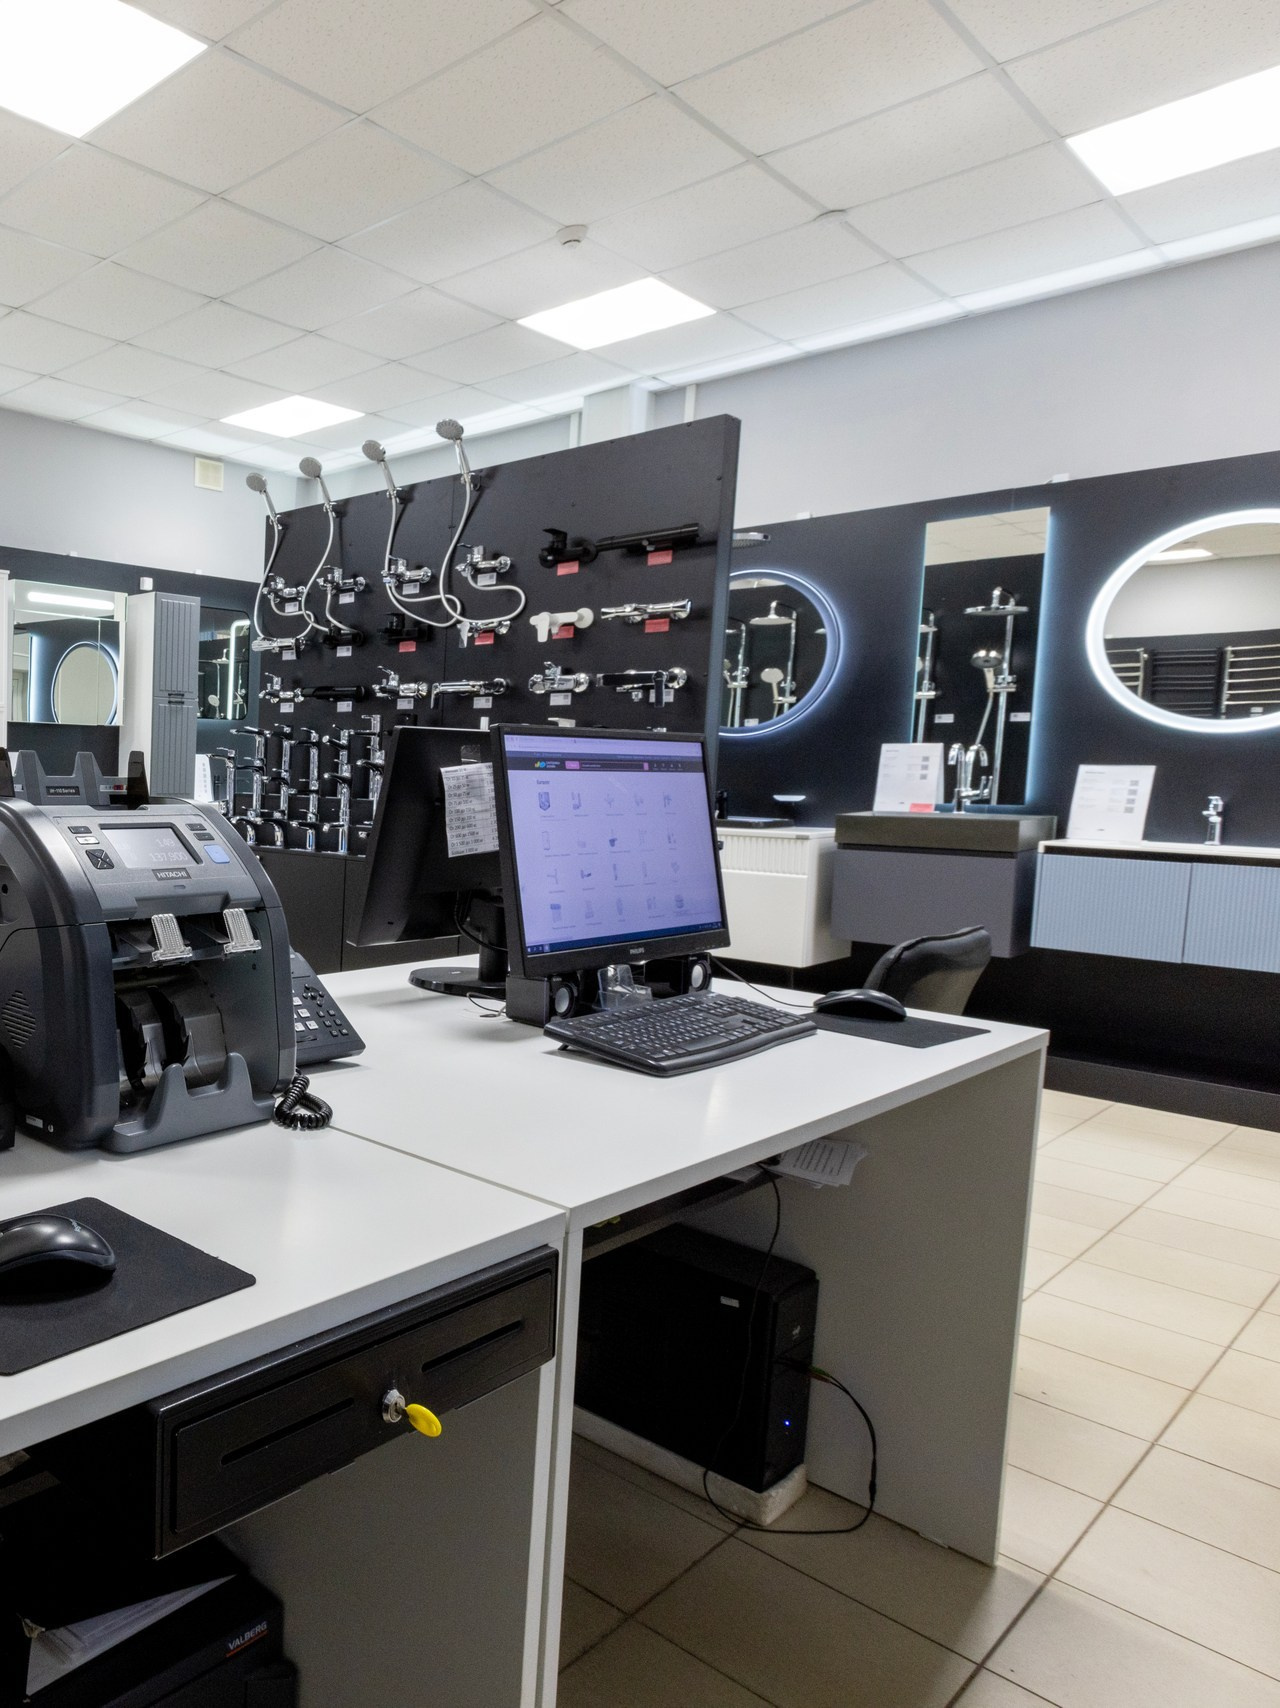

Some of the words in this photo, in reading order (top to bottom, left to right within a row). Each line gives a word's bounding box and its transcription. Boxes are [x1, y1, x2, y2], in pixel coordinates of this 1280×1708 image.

[156, 837, 175, 847] 149
[156, 870, 187, 879] HITACHI
[228, 1620, 268, 1651] VALBERG
